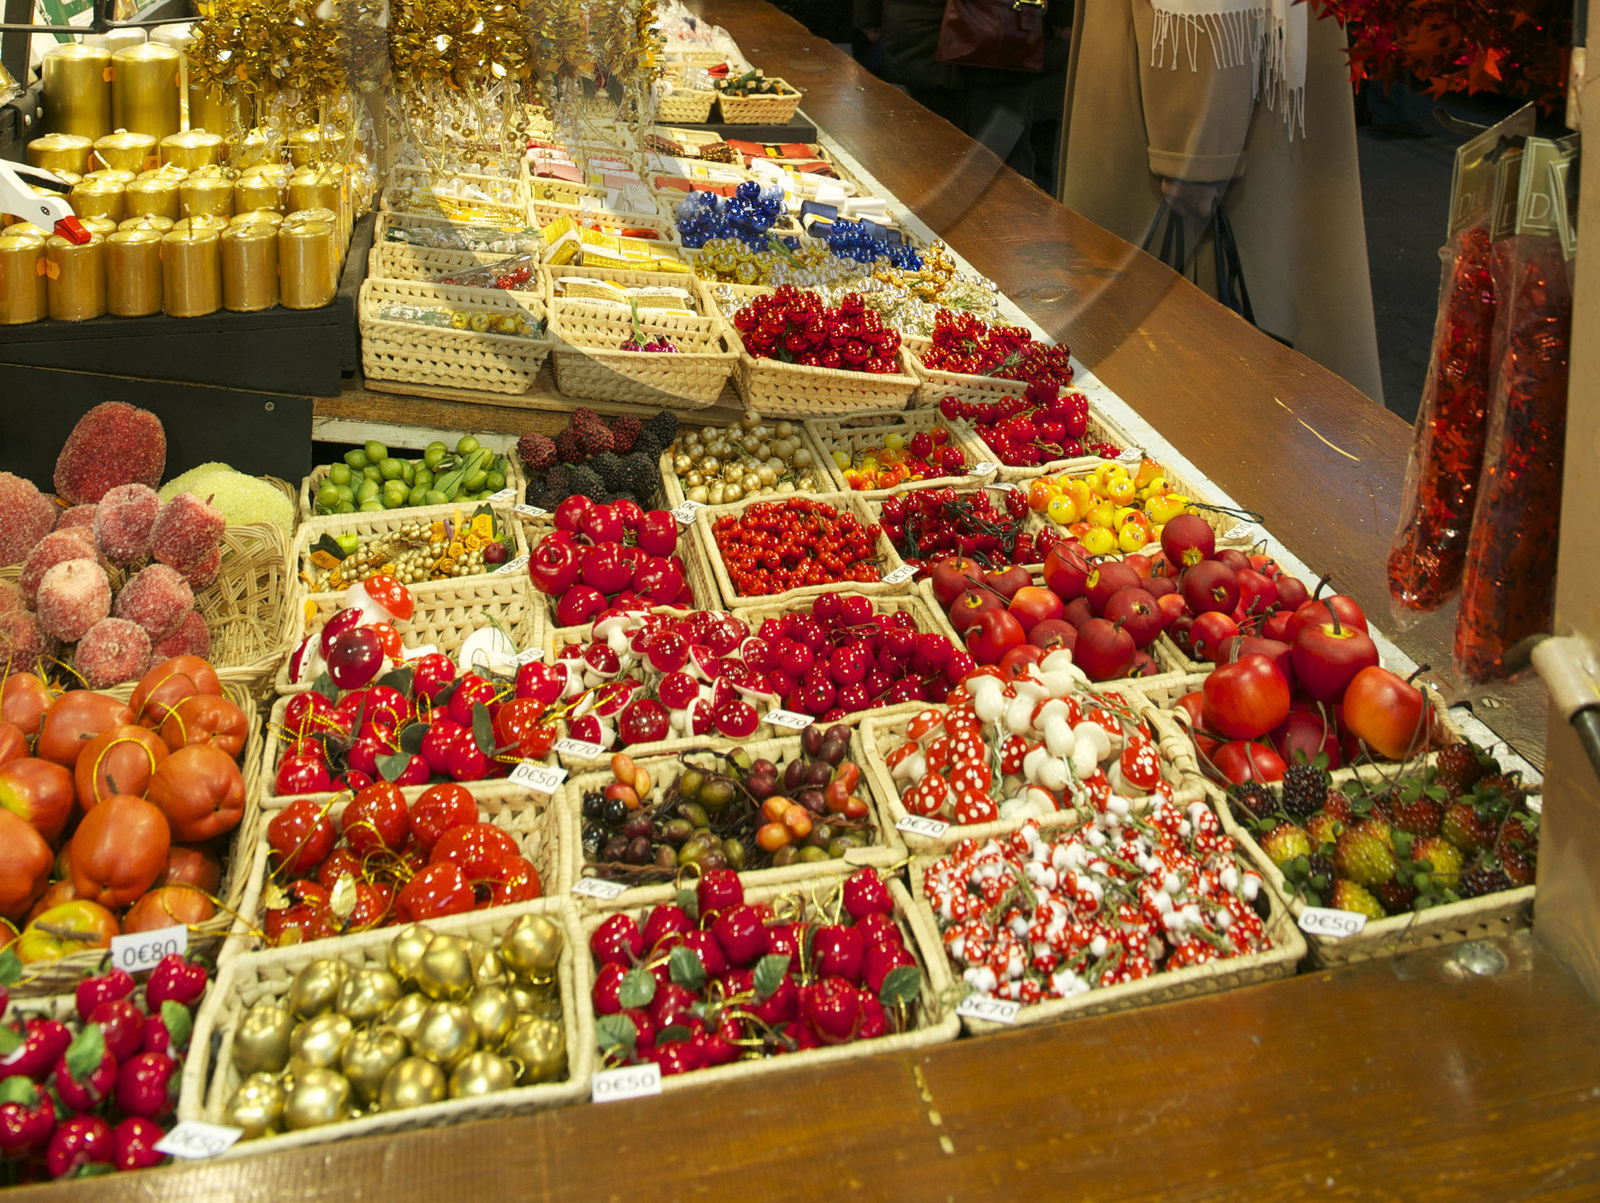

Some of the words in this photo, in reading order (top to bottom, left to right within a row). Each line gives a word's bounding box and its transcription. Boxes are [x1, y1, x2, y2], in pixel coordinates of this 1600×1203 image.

[767, 712, 808, 728] 0€70
[558, 740, 599, 756] 0€70
[516, 765, 559, 788] 0€50
[900, 816, 945, 834] 0€70
[1304, 913, 1358, 933] 0€50
[122, 939, 178, 967] 0€80
[960, 999, 1014, 1017] 0€70
[597, 1073, 655, 1094] 0€50
